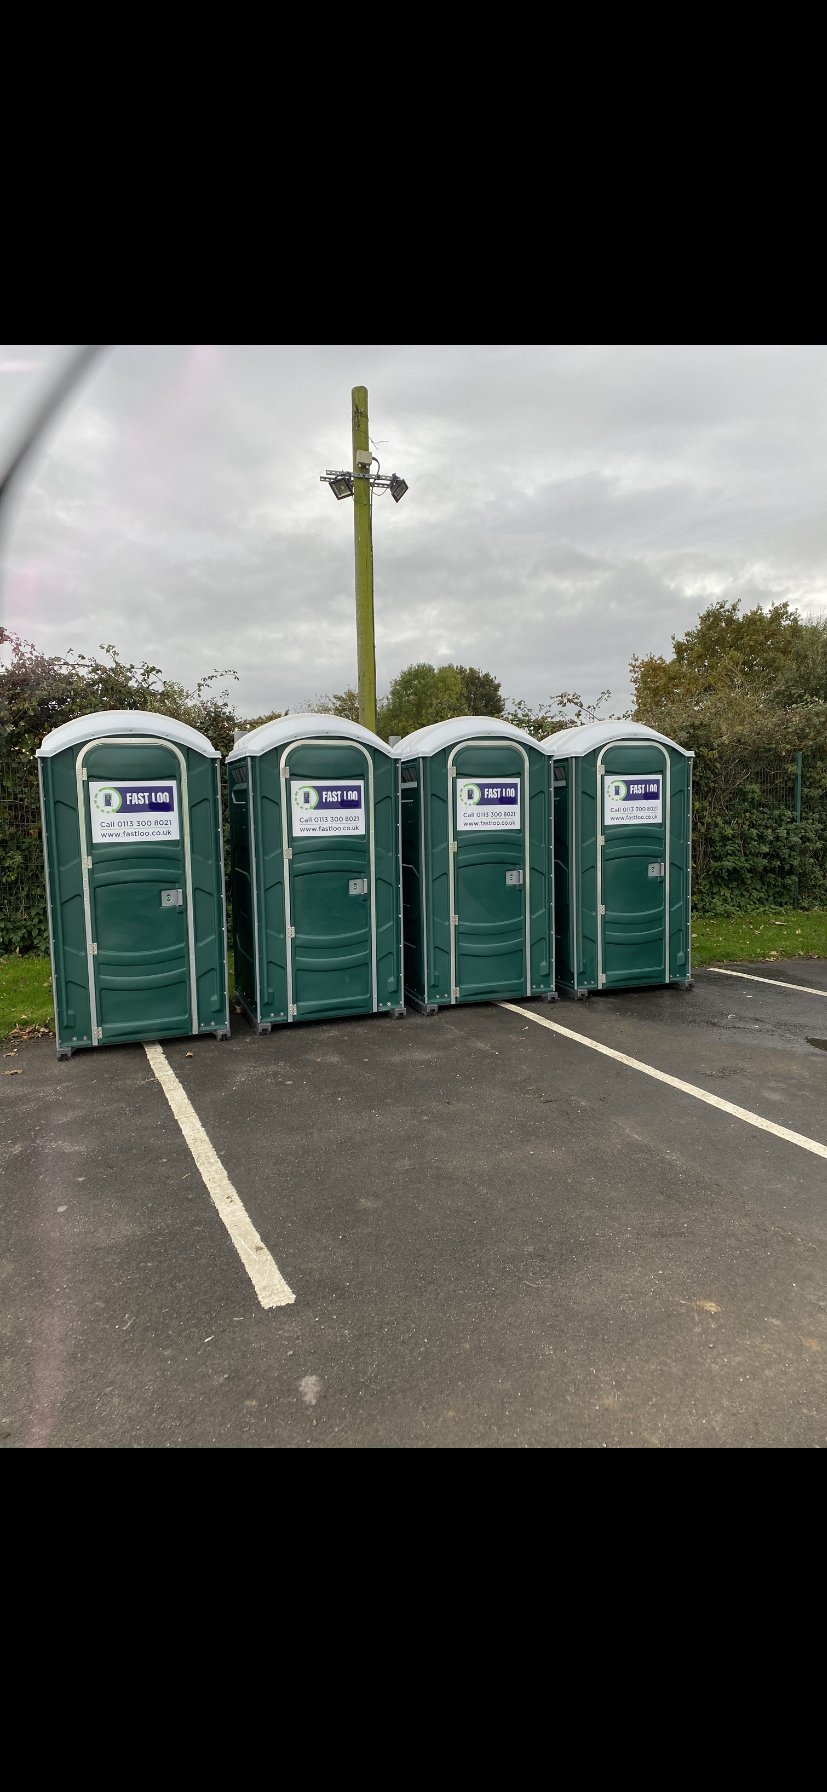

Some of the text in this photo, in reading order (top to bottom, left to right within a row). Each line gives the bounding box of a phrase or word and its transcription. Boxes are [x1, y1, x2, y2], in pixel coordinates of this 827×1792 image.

[484, 788, 515, 798] FAST LOO
[630, 784, 645, 794] FAST
[126, 792, 170, 804] FAST LOO
[322, 791, 358, 802] FAST LOO
[100, 830, 172, 838] www.fastloo.co.uk
